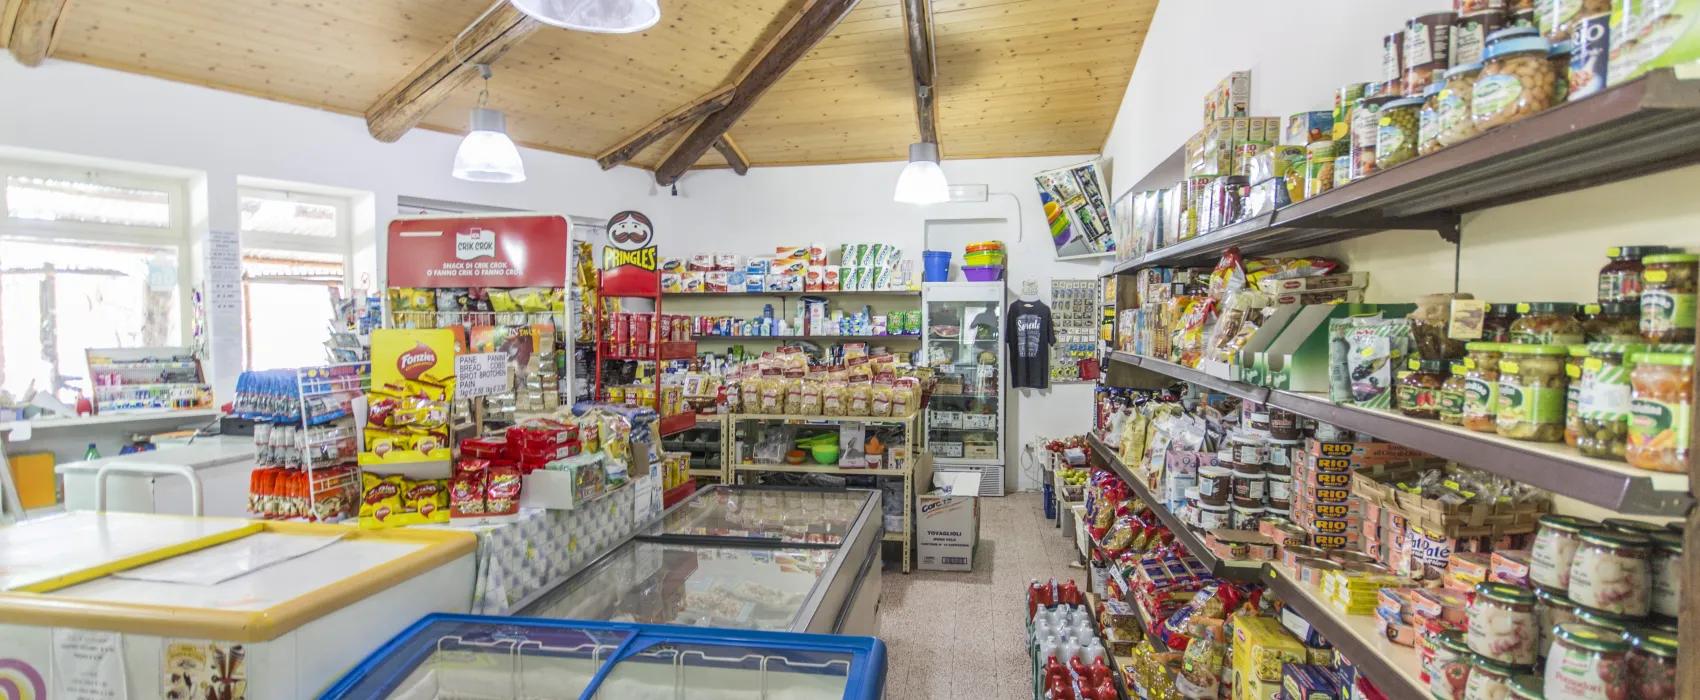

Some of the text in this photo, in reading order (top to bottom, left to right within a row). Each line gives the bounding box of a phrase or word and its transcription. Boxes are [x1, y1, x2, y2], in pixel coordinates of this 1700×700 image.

[458, 242, 493, 251] CRIK CROK
[604, 247, 656, 271] PRINGLES
[401, 352, 436, 369] Fonzies
[460, 356, 477, 364] PANE
[460, 363, 482, 373] BREAD
[460, 372, 477, 380] BROT
[460, 380, 475, 389] PAIN
[1323, 444, 1352, 452] RIO
[1319, 459, 1349, 468] RIO
[1318, 474, 1348, 483] RIO
[1317, 490, 1347, 499] RIO
[1317, 505, 1346, 514] RIO
[1315, 520, 1346, 529] RIO
[1315, 536, 1345, 545] RIO
